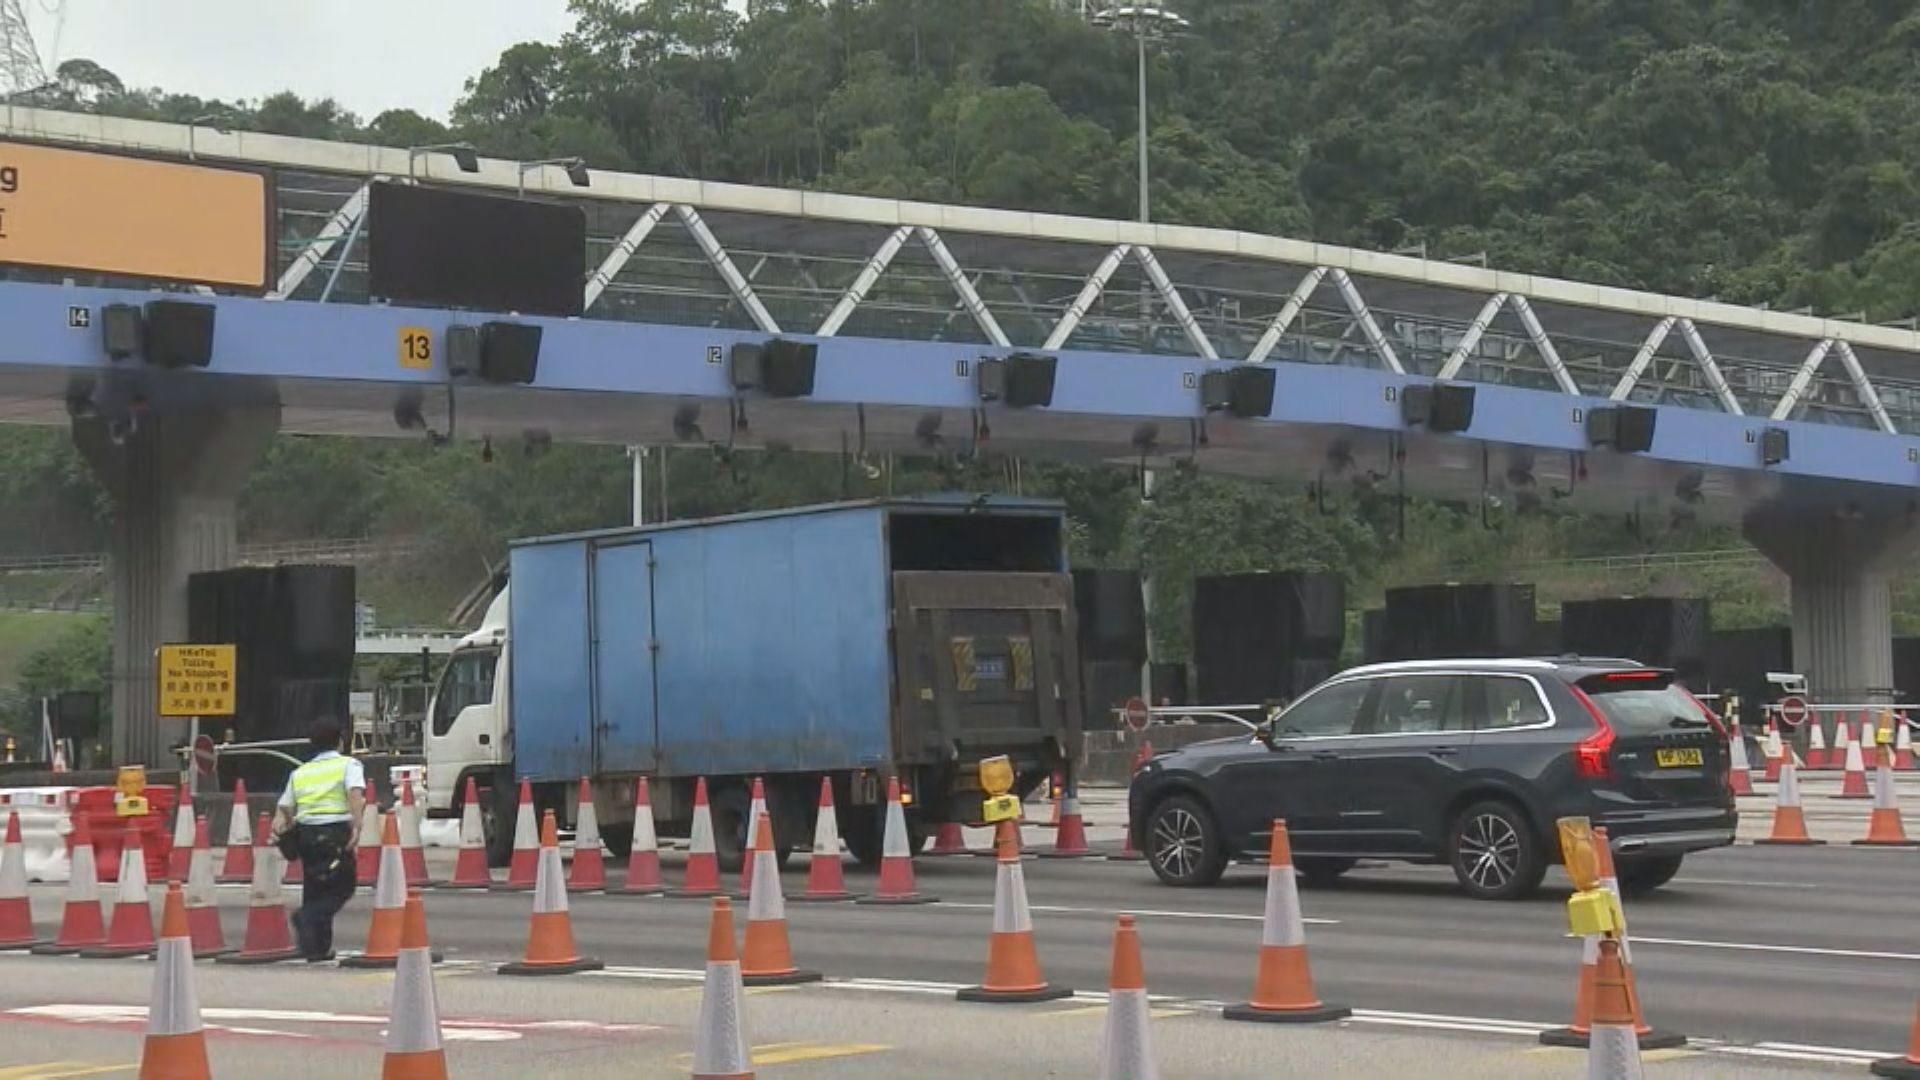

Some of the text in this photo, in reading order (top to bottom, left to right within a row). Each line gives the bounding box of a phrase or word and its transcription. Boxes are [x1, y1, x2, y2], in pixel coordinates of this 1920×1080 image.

[71, 307, 88, 327] 14
[403, 334, 430, 360] 13
[708, 347, 721, 362] 12
[958, 360, 968, 377] 11
[168, 669, 182, 678] No
